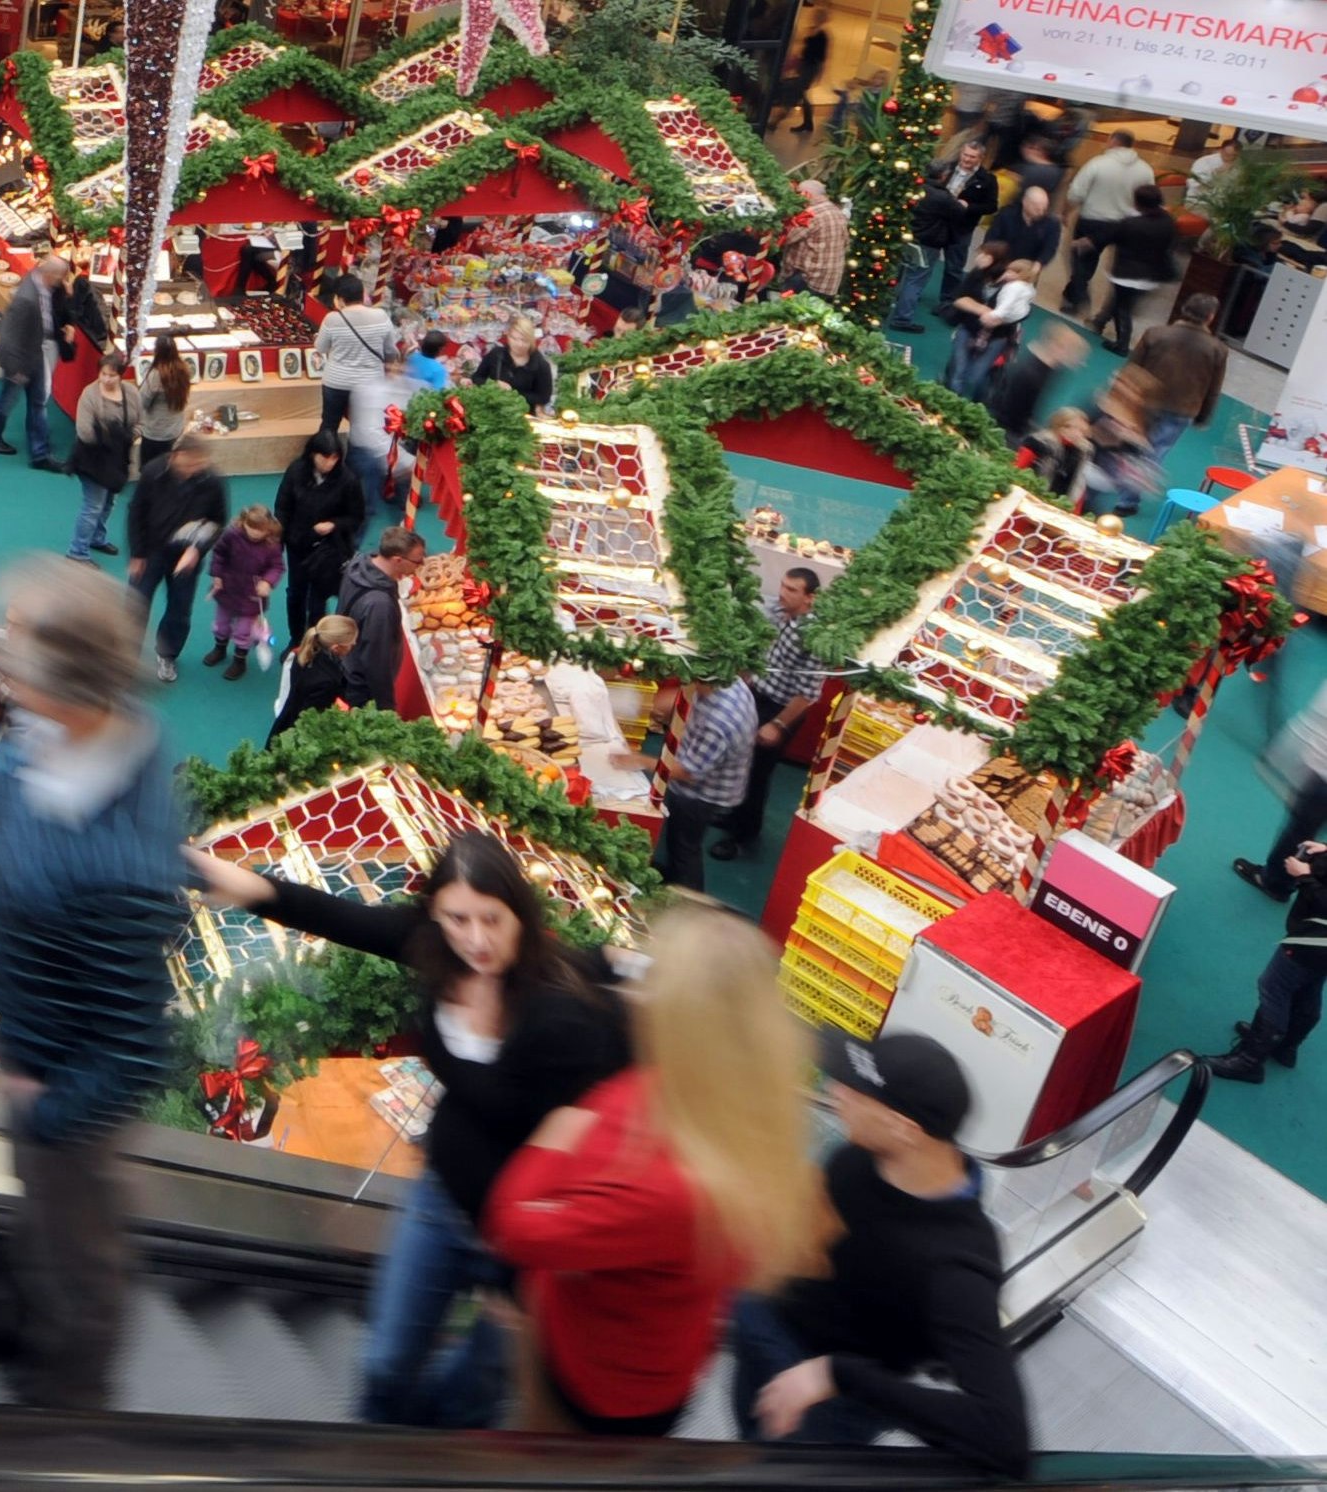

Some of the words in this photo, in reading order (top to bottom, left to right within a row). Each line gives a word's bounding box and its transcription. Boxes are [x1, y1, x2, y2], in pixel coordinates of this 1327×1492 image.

[1042, 28, 1071, 41] von
[1134, 39, 1158, 54] bis
[1223, 52, 1267, 69] 2011
[1043, 891, 1113, 942] EBENE
